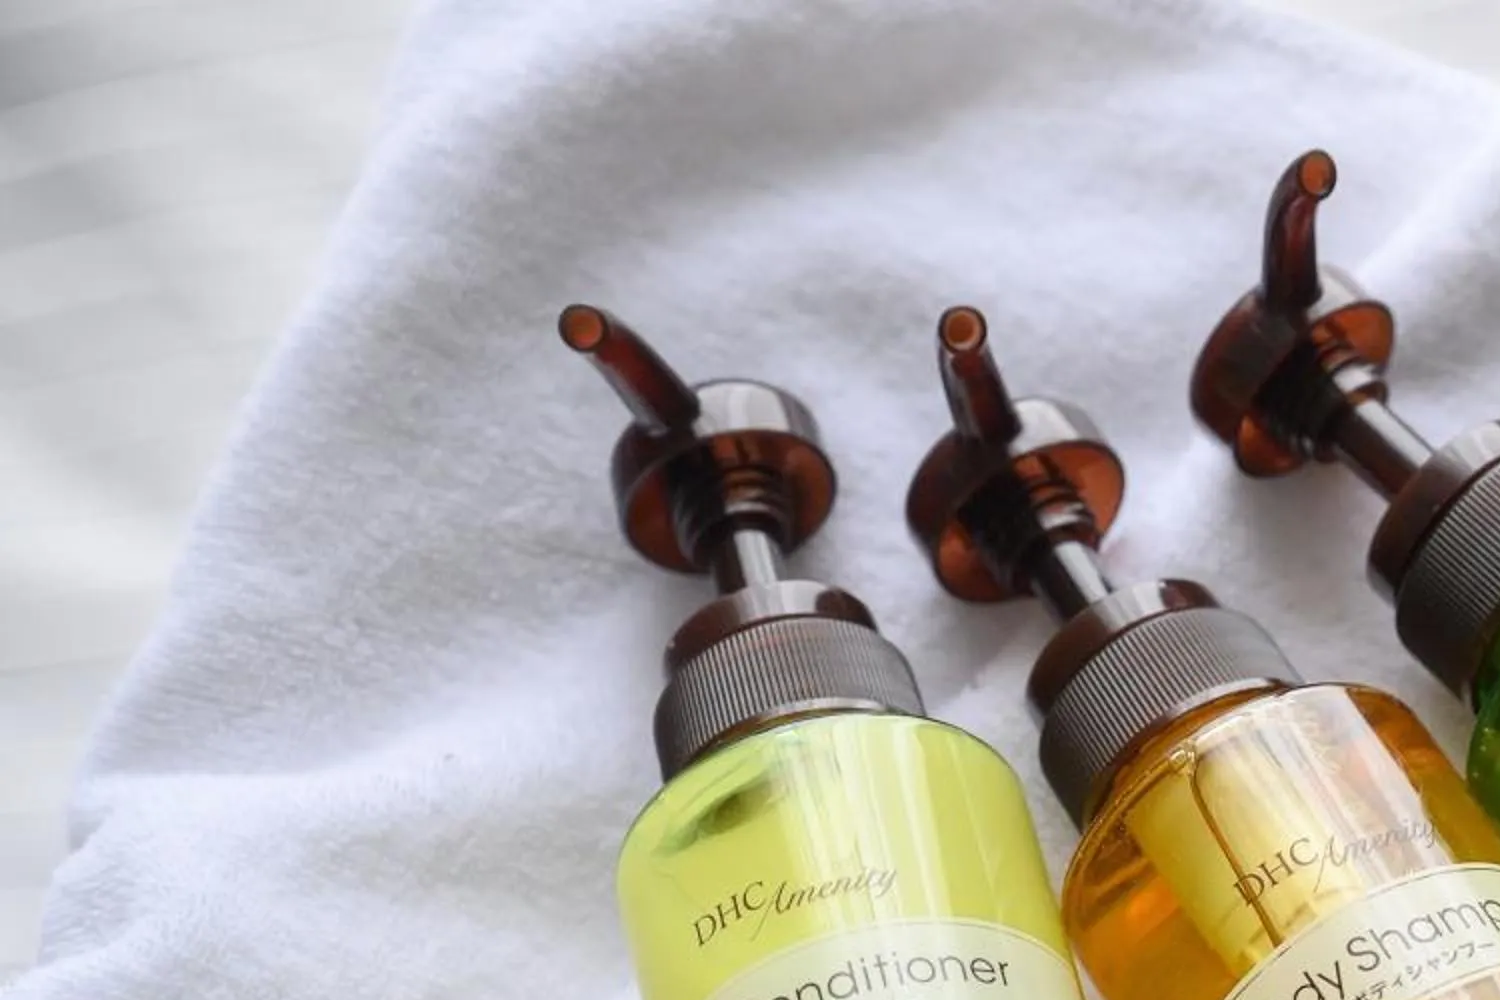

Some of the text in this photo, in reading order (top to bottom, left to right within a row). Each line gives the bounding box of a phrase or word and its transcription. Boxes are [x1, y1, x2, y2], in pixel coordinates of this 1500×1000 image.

[1234, 819, 1440, 906] DHC Amenity
[693, 866, 896, 947] DHC Amenity
